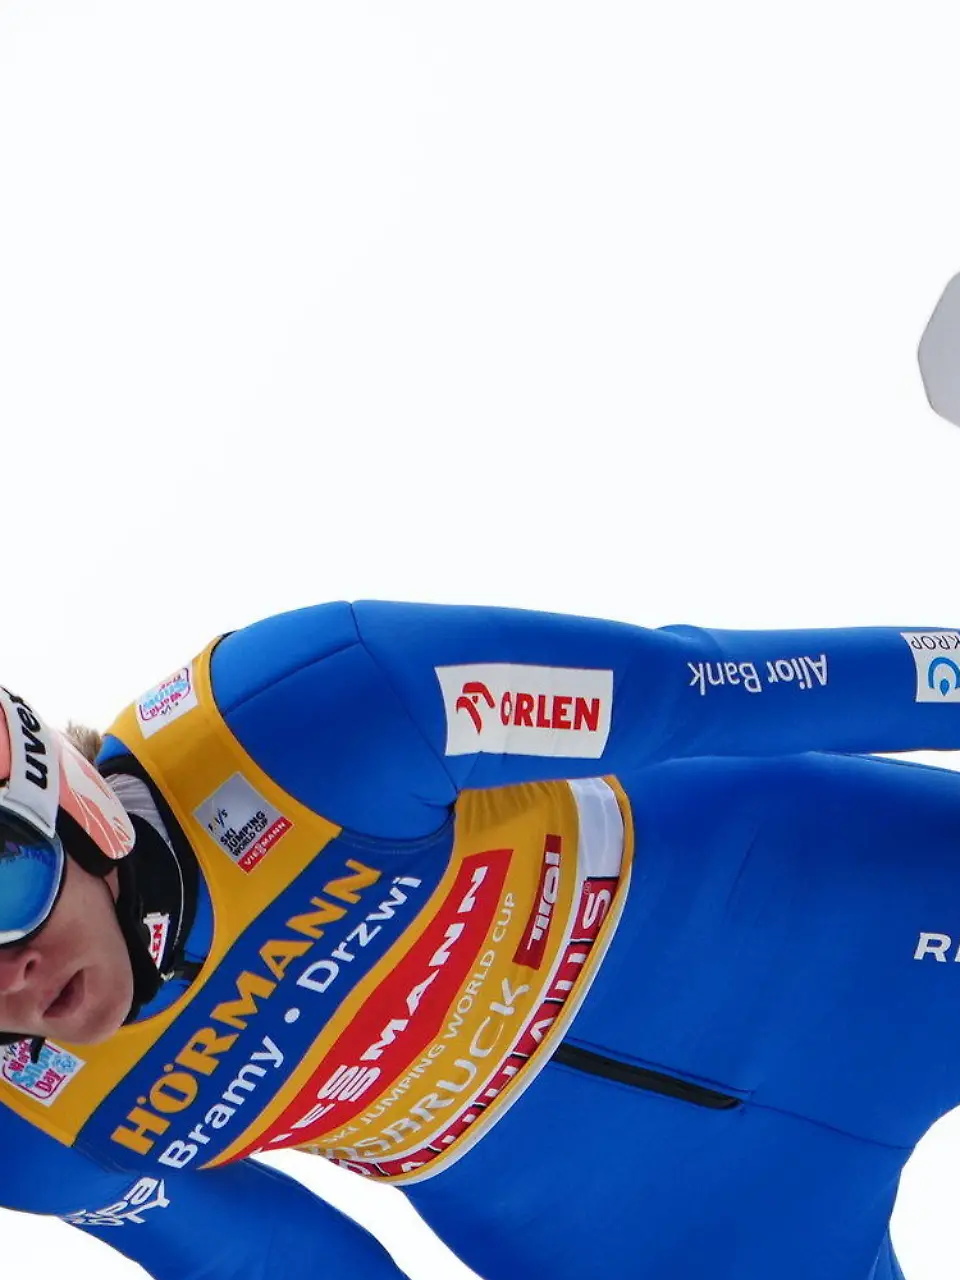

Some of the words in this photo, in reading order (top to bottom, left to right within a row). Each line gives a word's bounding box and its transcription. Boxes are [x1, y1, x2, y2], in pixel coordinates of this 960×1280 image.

[686, 661, 762, 695] Bank
[765, 654, 828, 691] Alior
[501, 691, 599, 732] ORLEN
[220, 828, 236, 845] SKI
[226, 811, 266, 852] JUMPING
[232, 832, 256, 856] WORLD
[255, 818, 268, 833] CUP
[158, 1035, 284, 1169] Bramy
[296, 875, 422, 994] Drzwi
[360, 1042, 447, 1126] JUMPING
[445, 950, 496, 1040] WORLD
[492, 891, 516, 942] CUP
